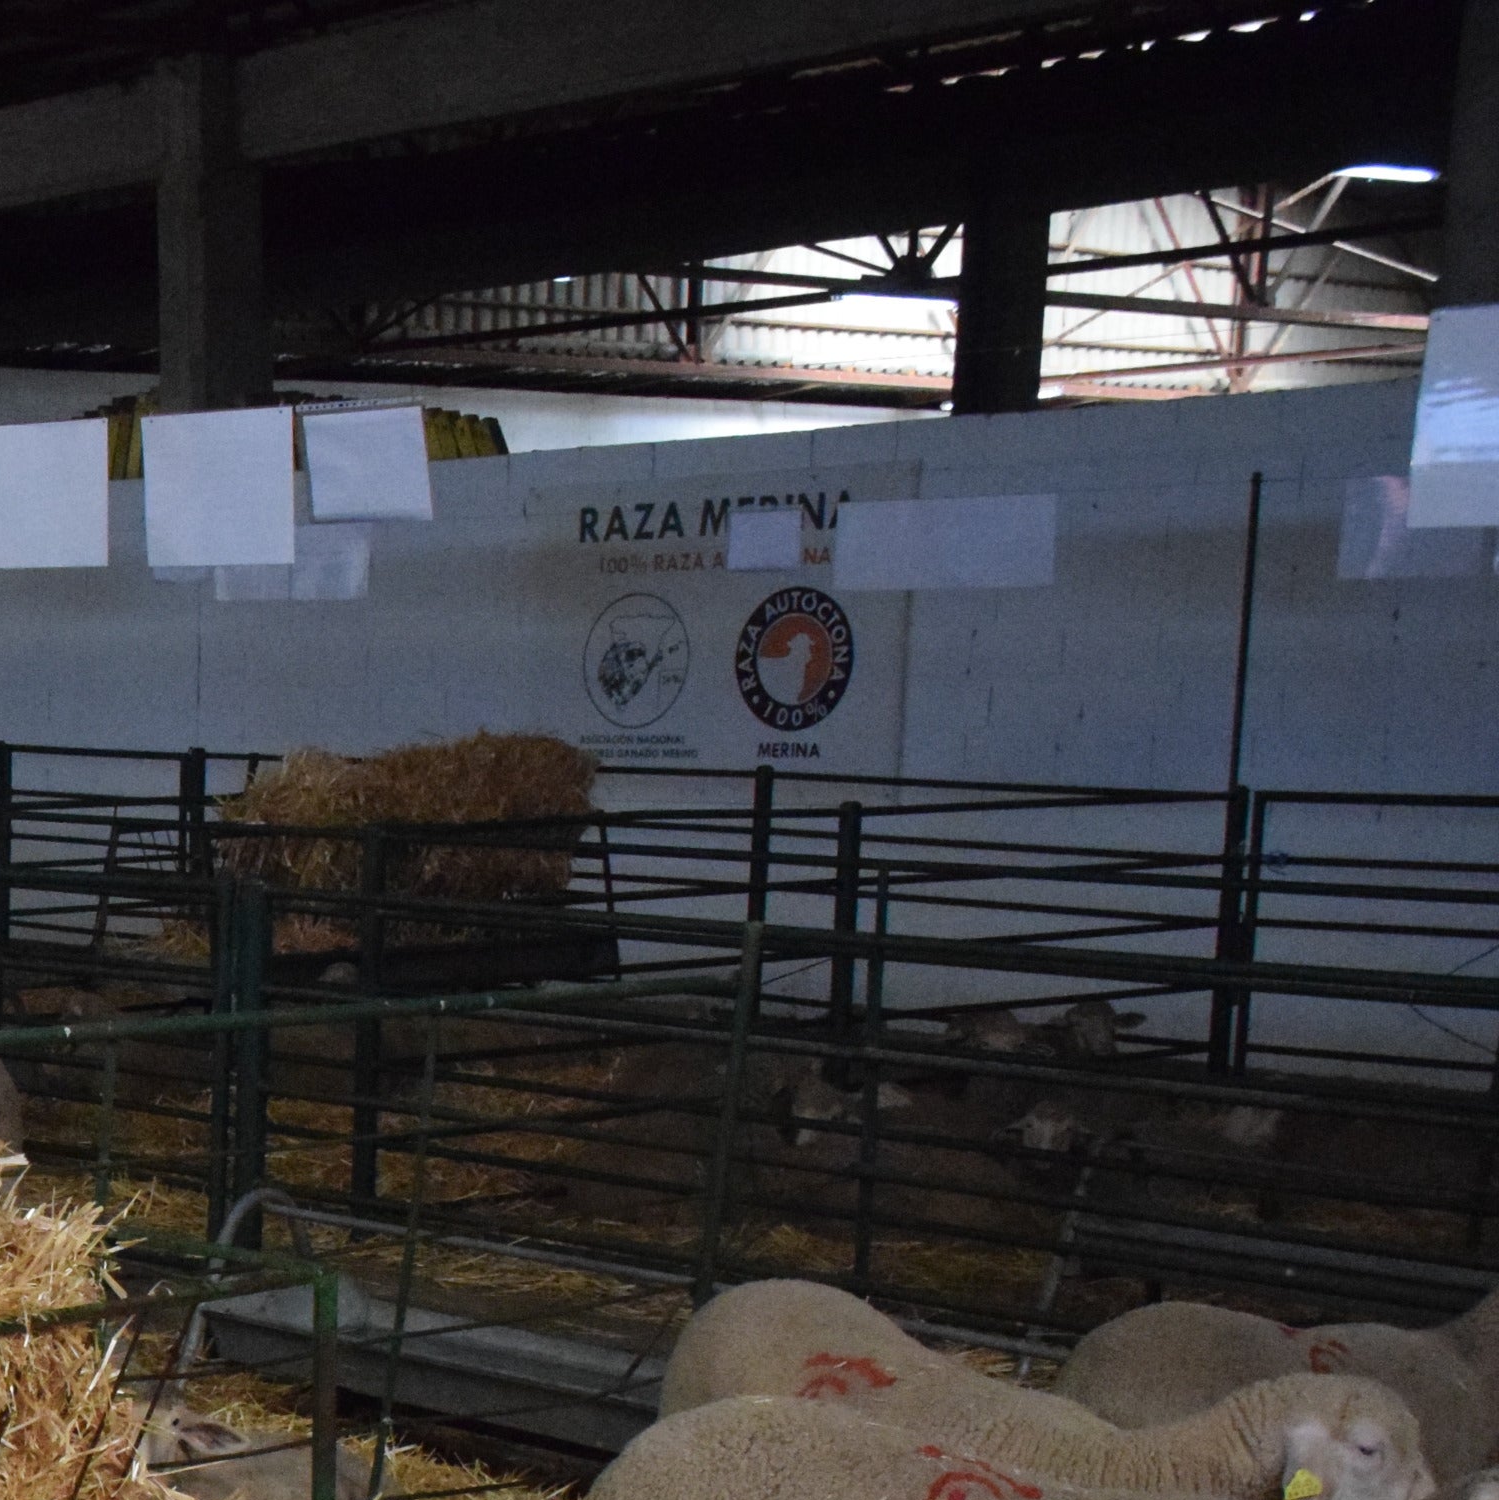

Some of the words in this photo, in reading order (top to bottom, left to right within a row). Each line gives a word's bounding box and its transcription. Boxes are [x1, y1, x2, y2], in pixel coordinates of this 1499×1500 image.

[579, 502, 684, 543] RAZA
[654, 552, 703, 572] RAZA
[737, 625, 763, 692] RAZA
[763, 698, 828, 726] 100%
[757, 742, 821, 759] MERINA
